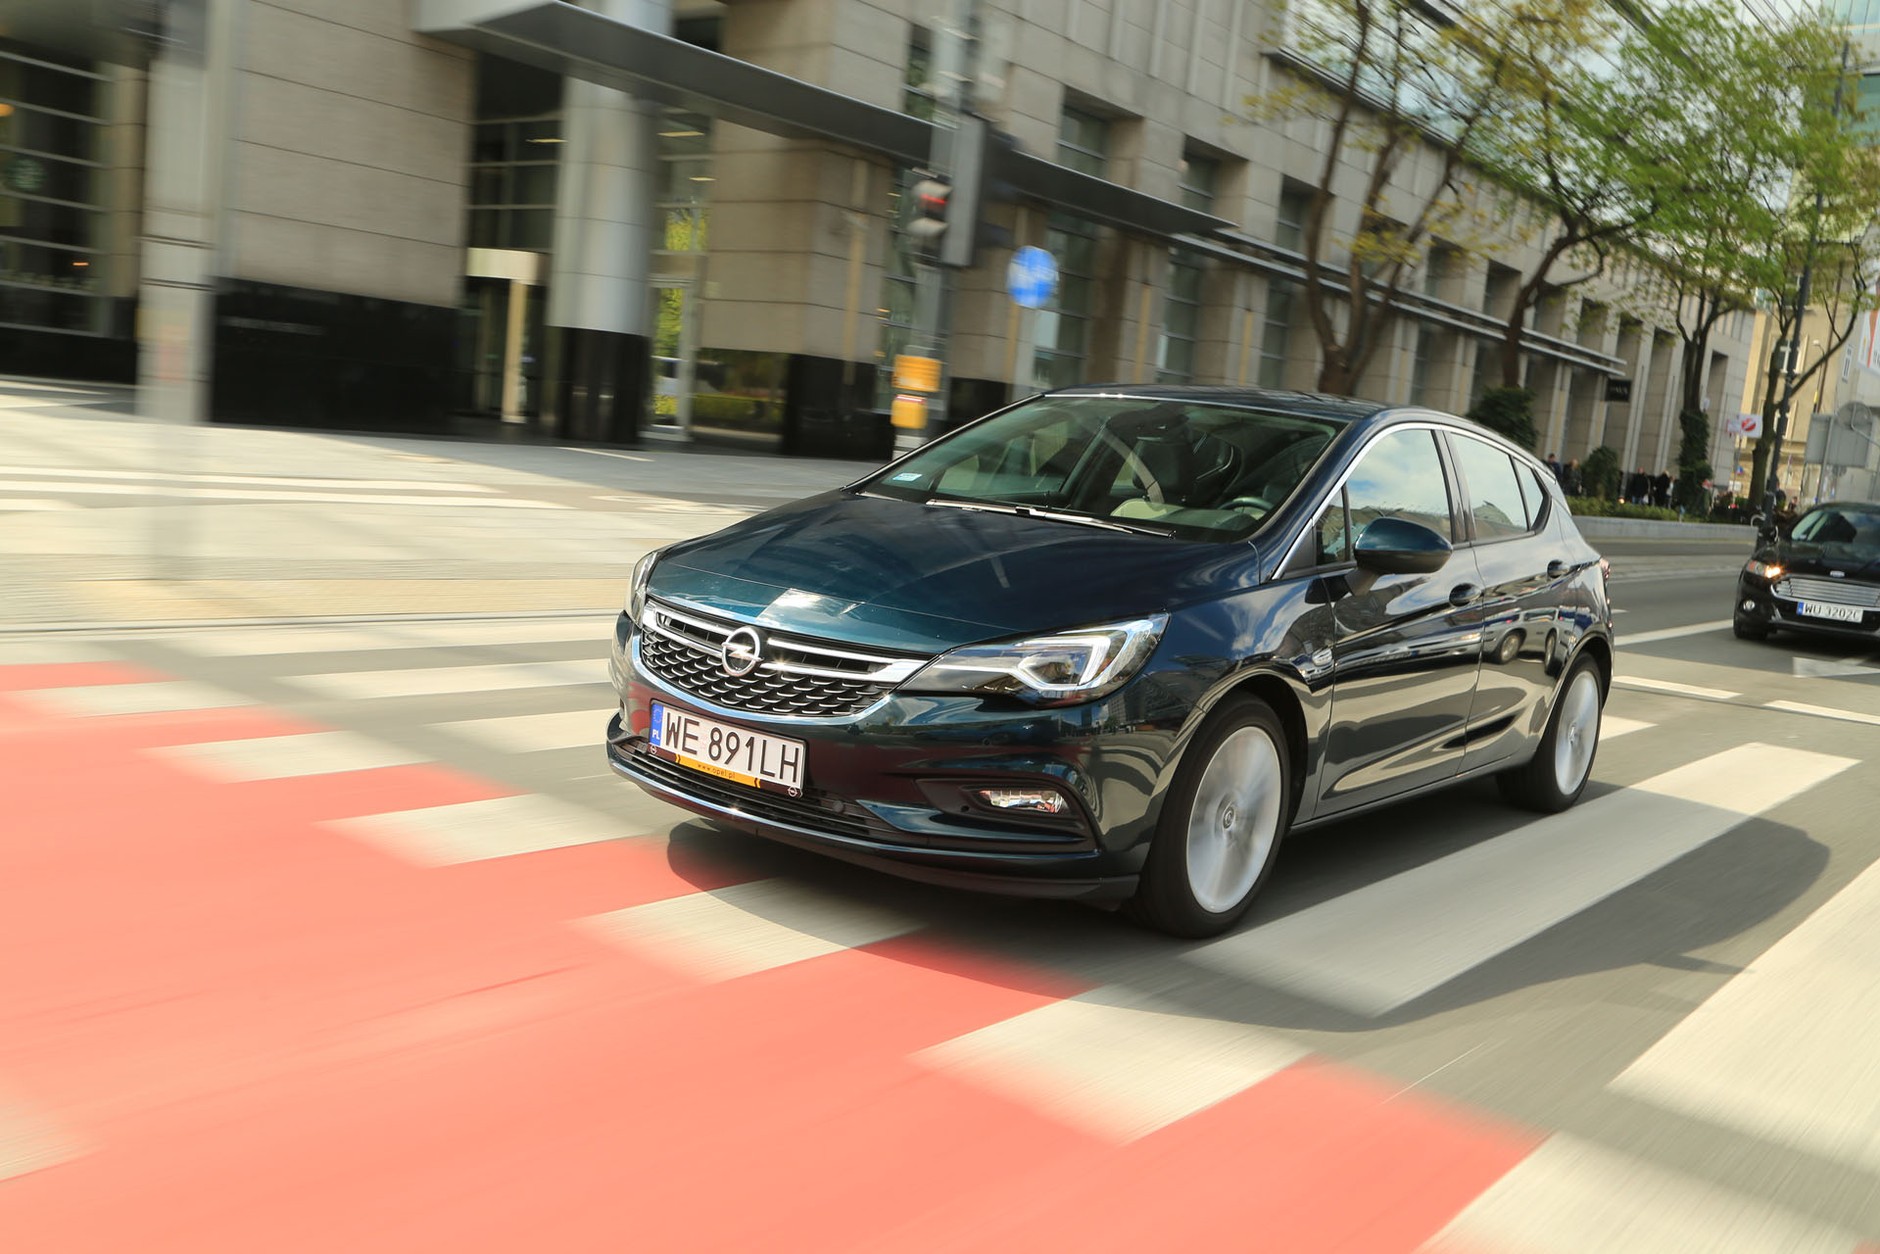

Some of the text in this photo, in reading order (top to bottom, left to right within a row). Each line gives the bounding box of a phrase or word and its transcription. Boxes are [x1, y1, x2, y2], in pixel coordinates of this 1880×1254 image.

[652, 729, 660, 740] PL
[666, 712, 800, 783] WE 891LH
